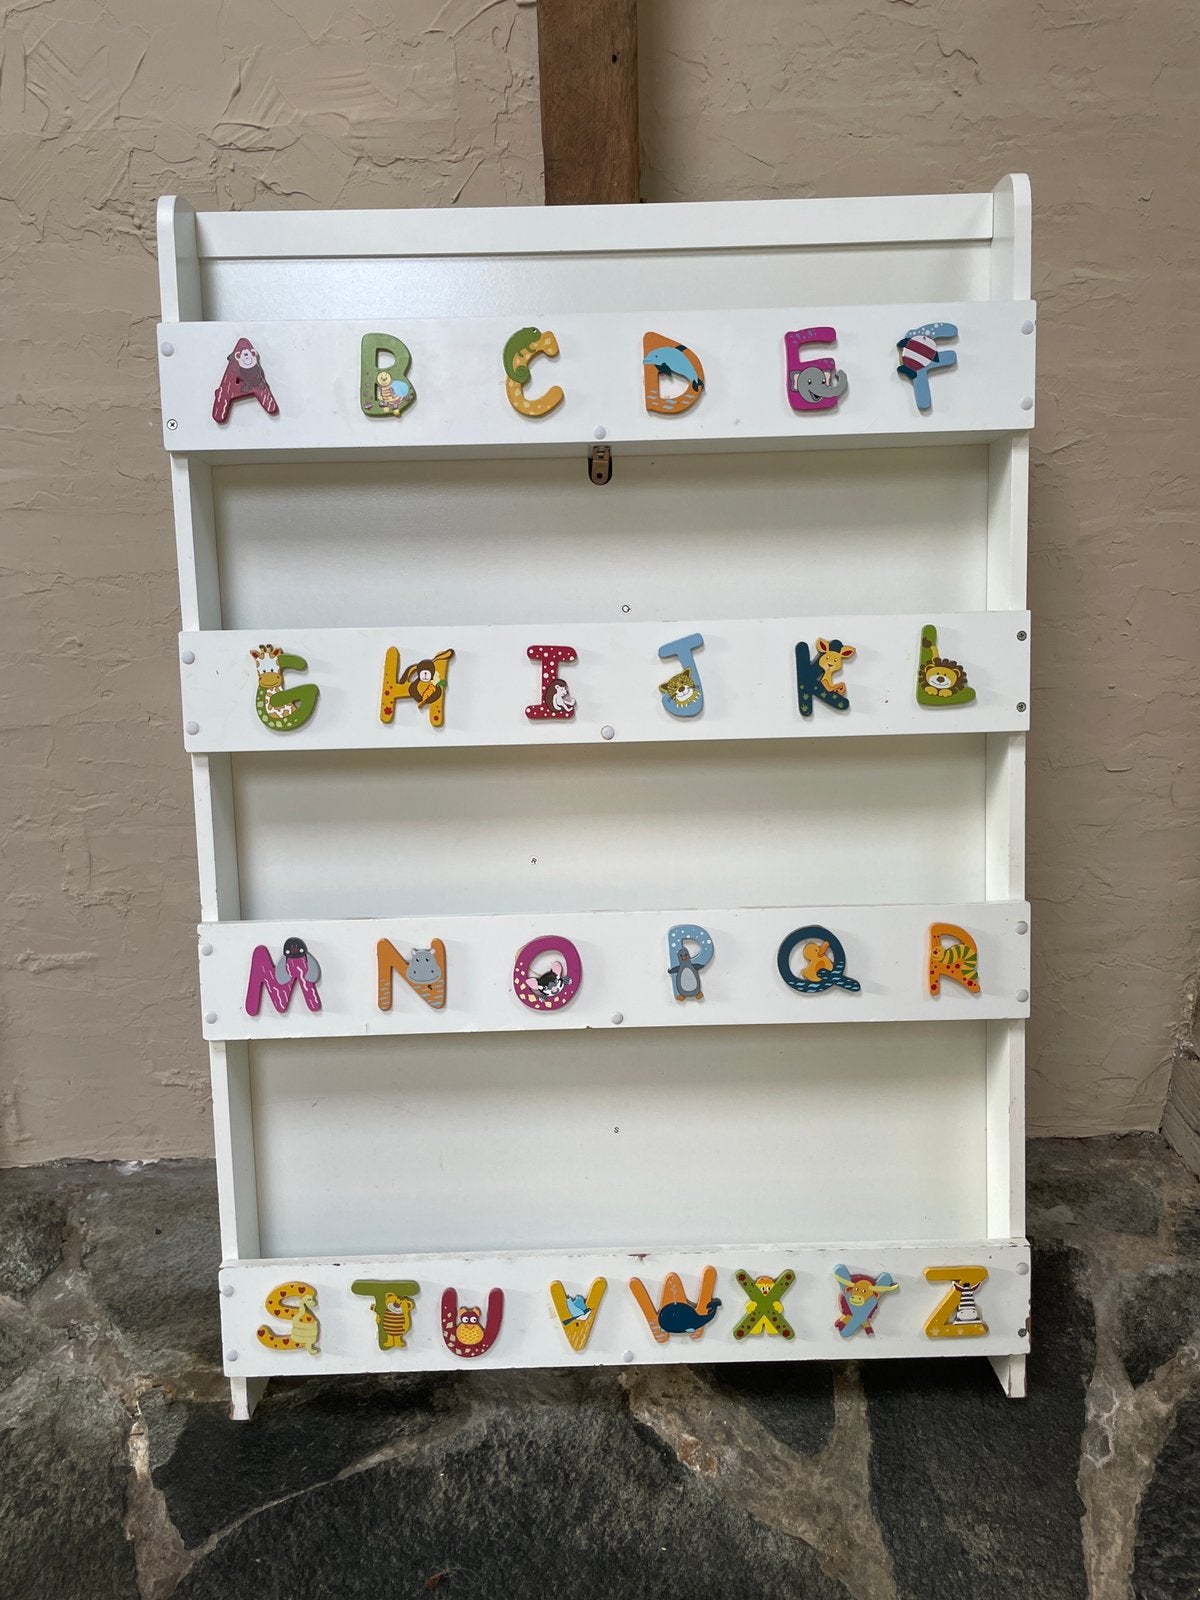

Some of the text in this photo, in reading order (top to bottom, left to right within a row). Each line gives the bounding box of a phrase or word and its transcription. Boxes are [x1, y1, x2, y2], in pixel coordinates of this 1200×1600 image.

[213, 323, 957, 423] A B C D E F
[251, 625, 976, 731] G H I J K L
[246, 922, 980, 1015] M N O P Q R
[257, 1263, 989, 1357] S T U V W X Y Z
